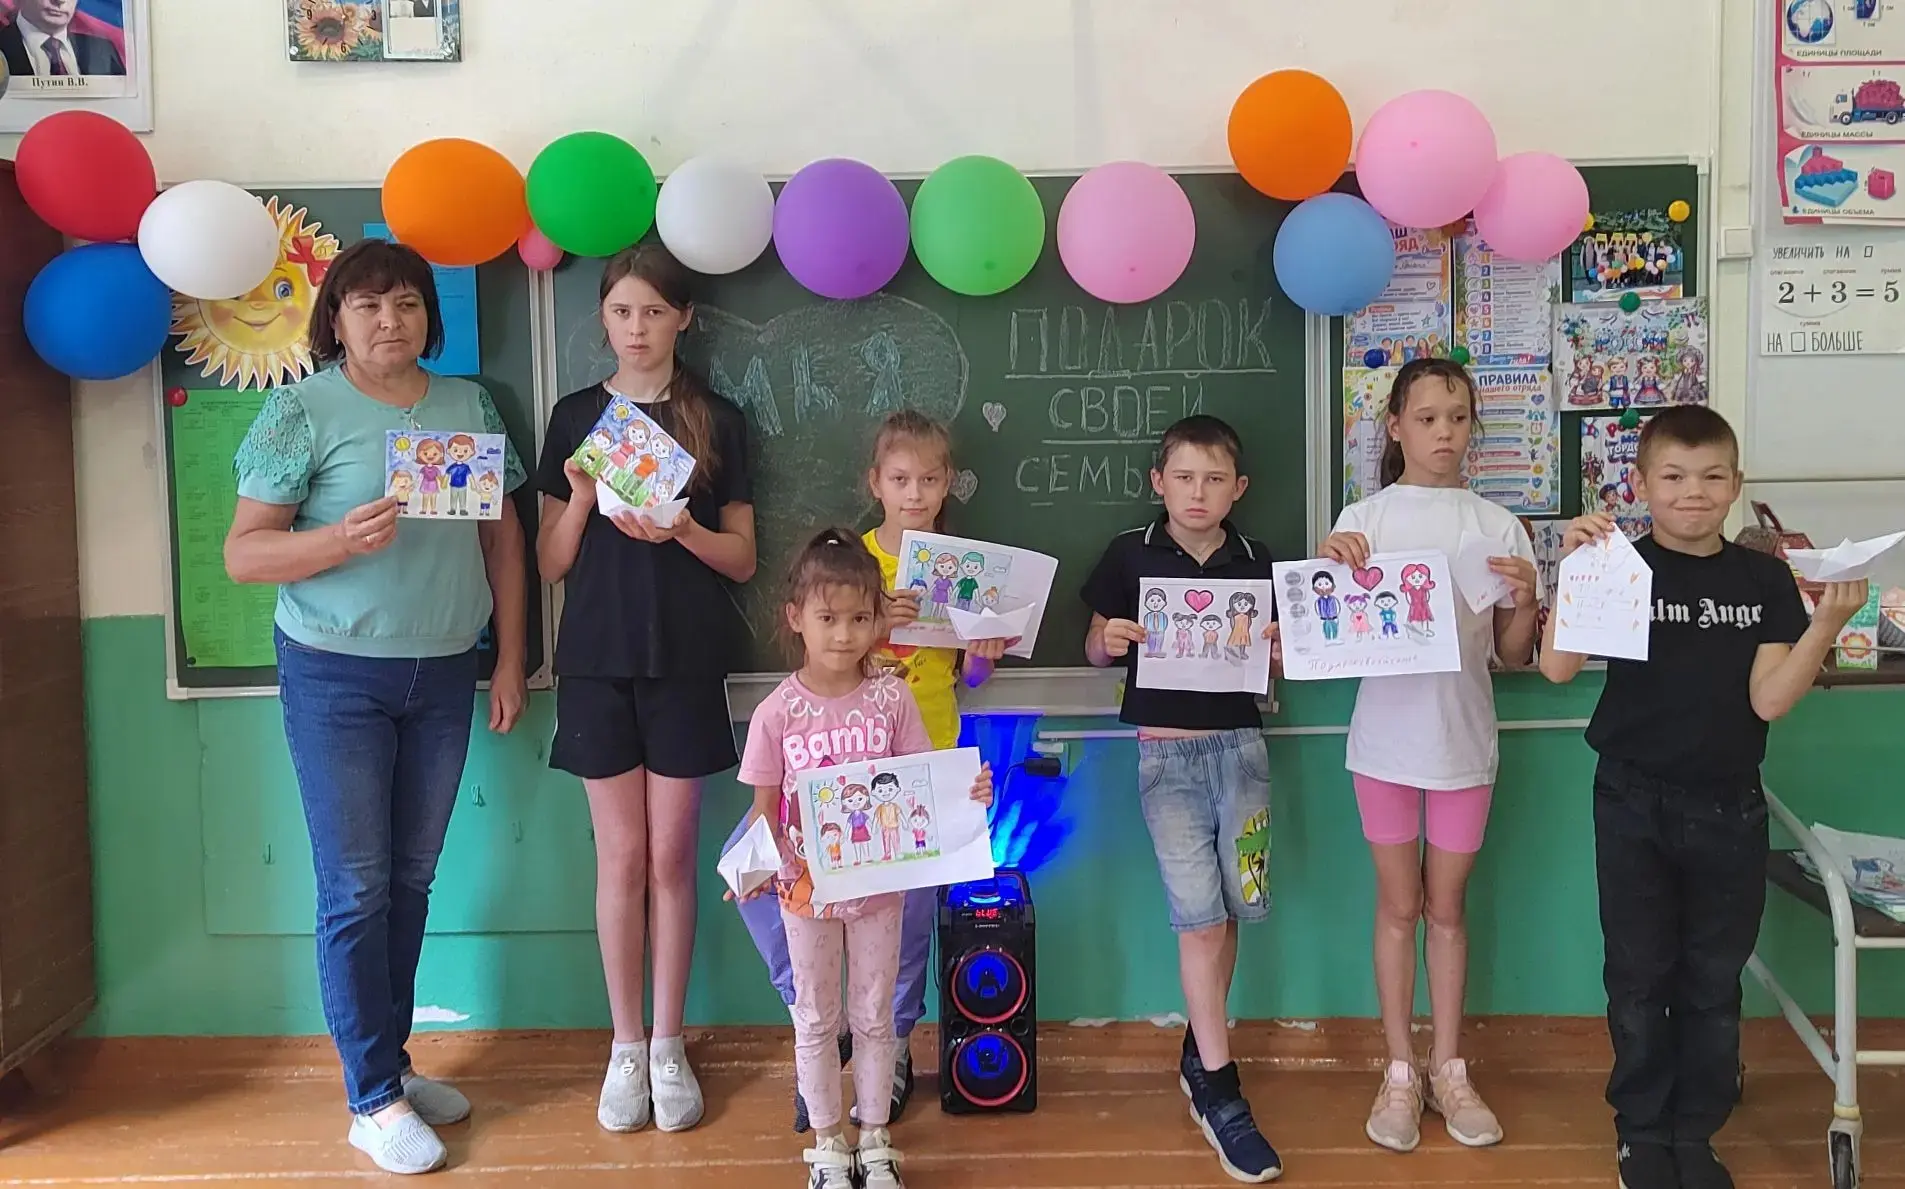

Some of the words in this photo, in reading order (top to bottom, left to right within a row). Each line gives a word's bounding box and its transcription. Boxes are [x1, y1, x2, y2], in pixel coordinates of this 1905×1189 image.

[306, 9, 313, 21] 9
[371, 9, 377, 21] 3
[340, 42, 347, 54] 6
[1796, 49, 1838, 57] ЕДИНИЦЫ
[1840, 49, 1882, 57] ПЛОЩАДИ
[32, 77, 64, 89] Путин
[67, 77, 89, 87] В.В.
[1800, 130, 1841, 138] ЕДИНИЦЫ
[1842, 130, 1873, 138] МАССЫ
[1772, 245, 1825, 260] УВЕЛИЧИТЬ
[1835, 245, 1851, 259] НА
[1778, 281, 1795, 304] 2
[1831, 280, 1847, 304] 3
[1884, 279, 1900, 303] 5
[1009, 296, 1273, 379] ПОДАРОК
[1767, 332, 1783, 353] НА
[1811, 330, 1864, 352] БОЛЬШЕ
[709, 330, 905, 437] МЬЯ
[1479, 374, 1537, 385] ПРАВИЛА
[1481, 384, 1511, 393] нашего
[1512, 384, 1542, 393] отряда
[1015, 452, 1161, 499] СЕМЬ
[782, 717, 888, 771] Bamb
